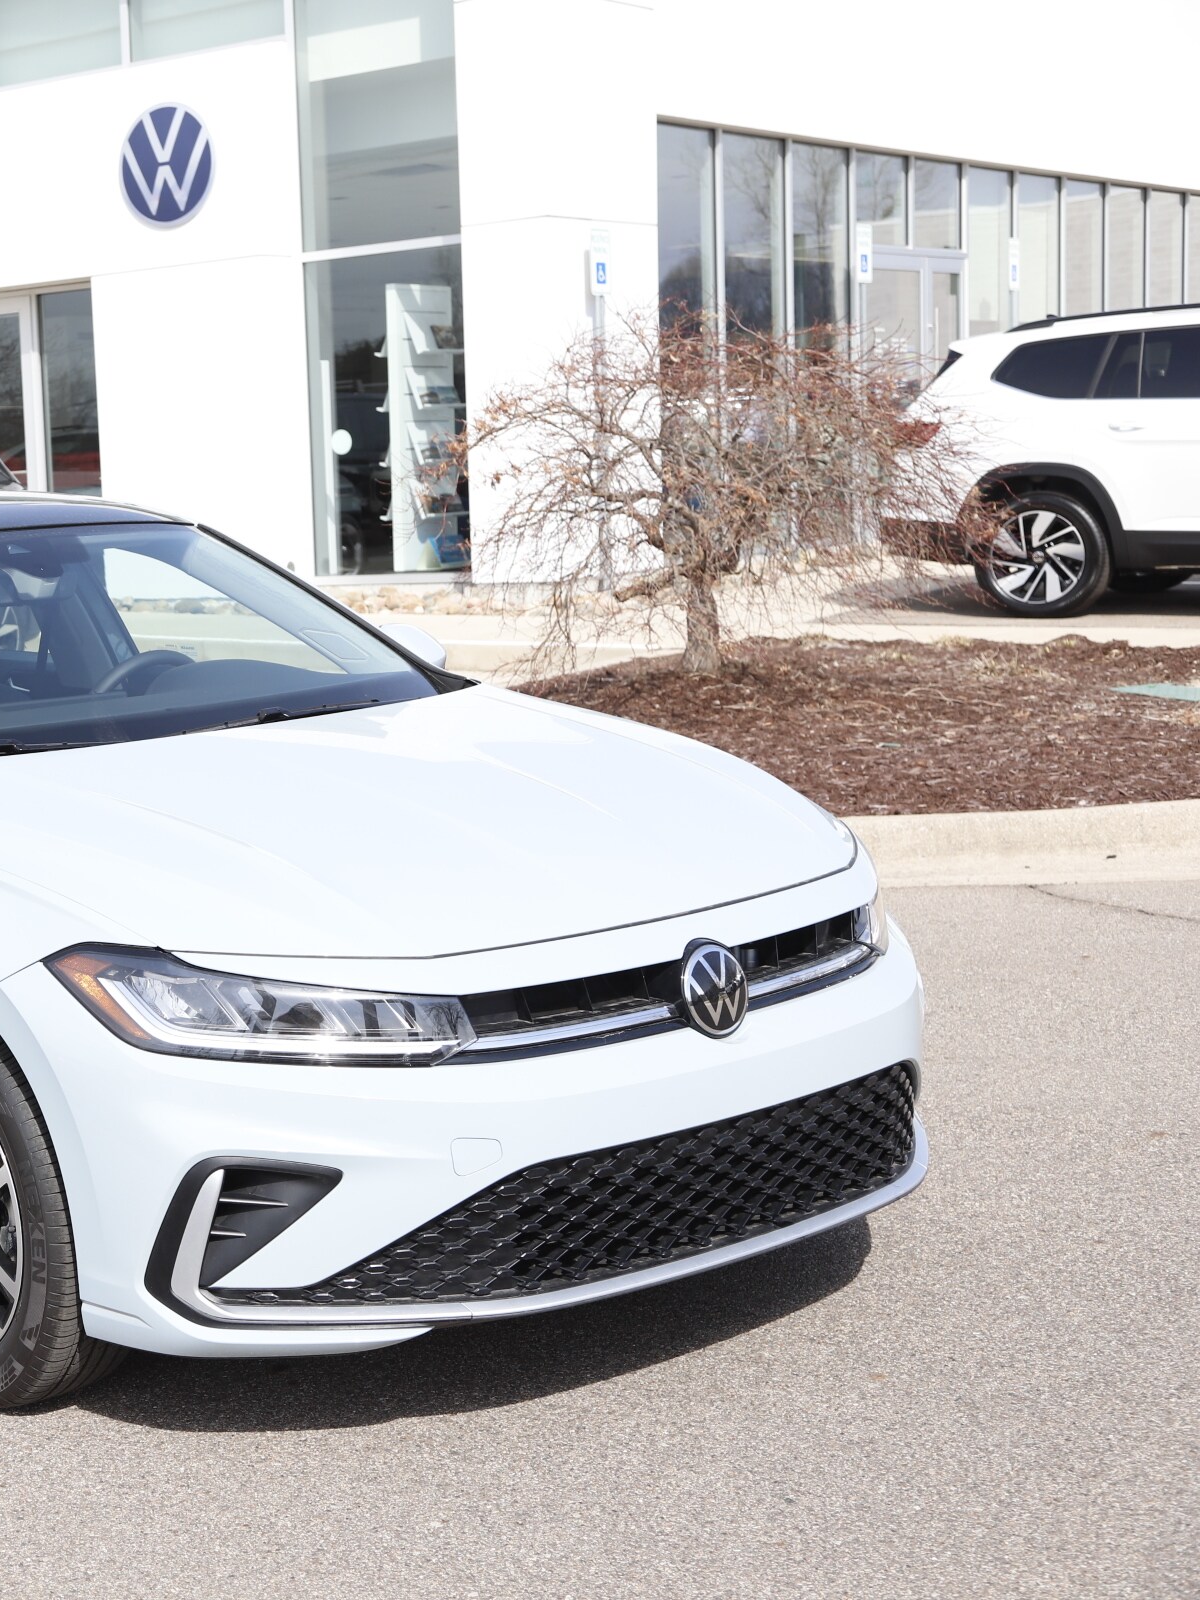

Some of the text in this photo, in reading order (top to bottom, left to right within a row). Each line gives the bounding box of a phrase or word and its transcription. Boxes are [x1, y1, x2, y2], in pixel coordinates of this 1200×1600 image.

[120, 104, 212, 220] VW
[686, 946, 744, 1030] VW
[18, 1159, 47, 1285] NEXEN
